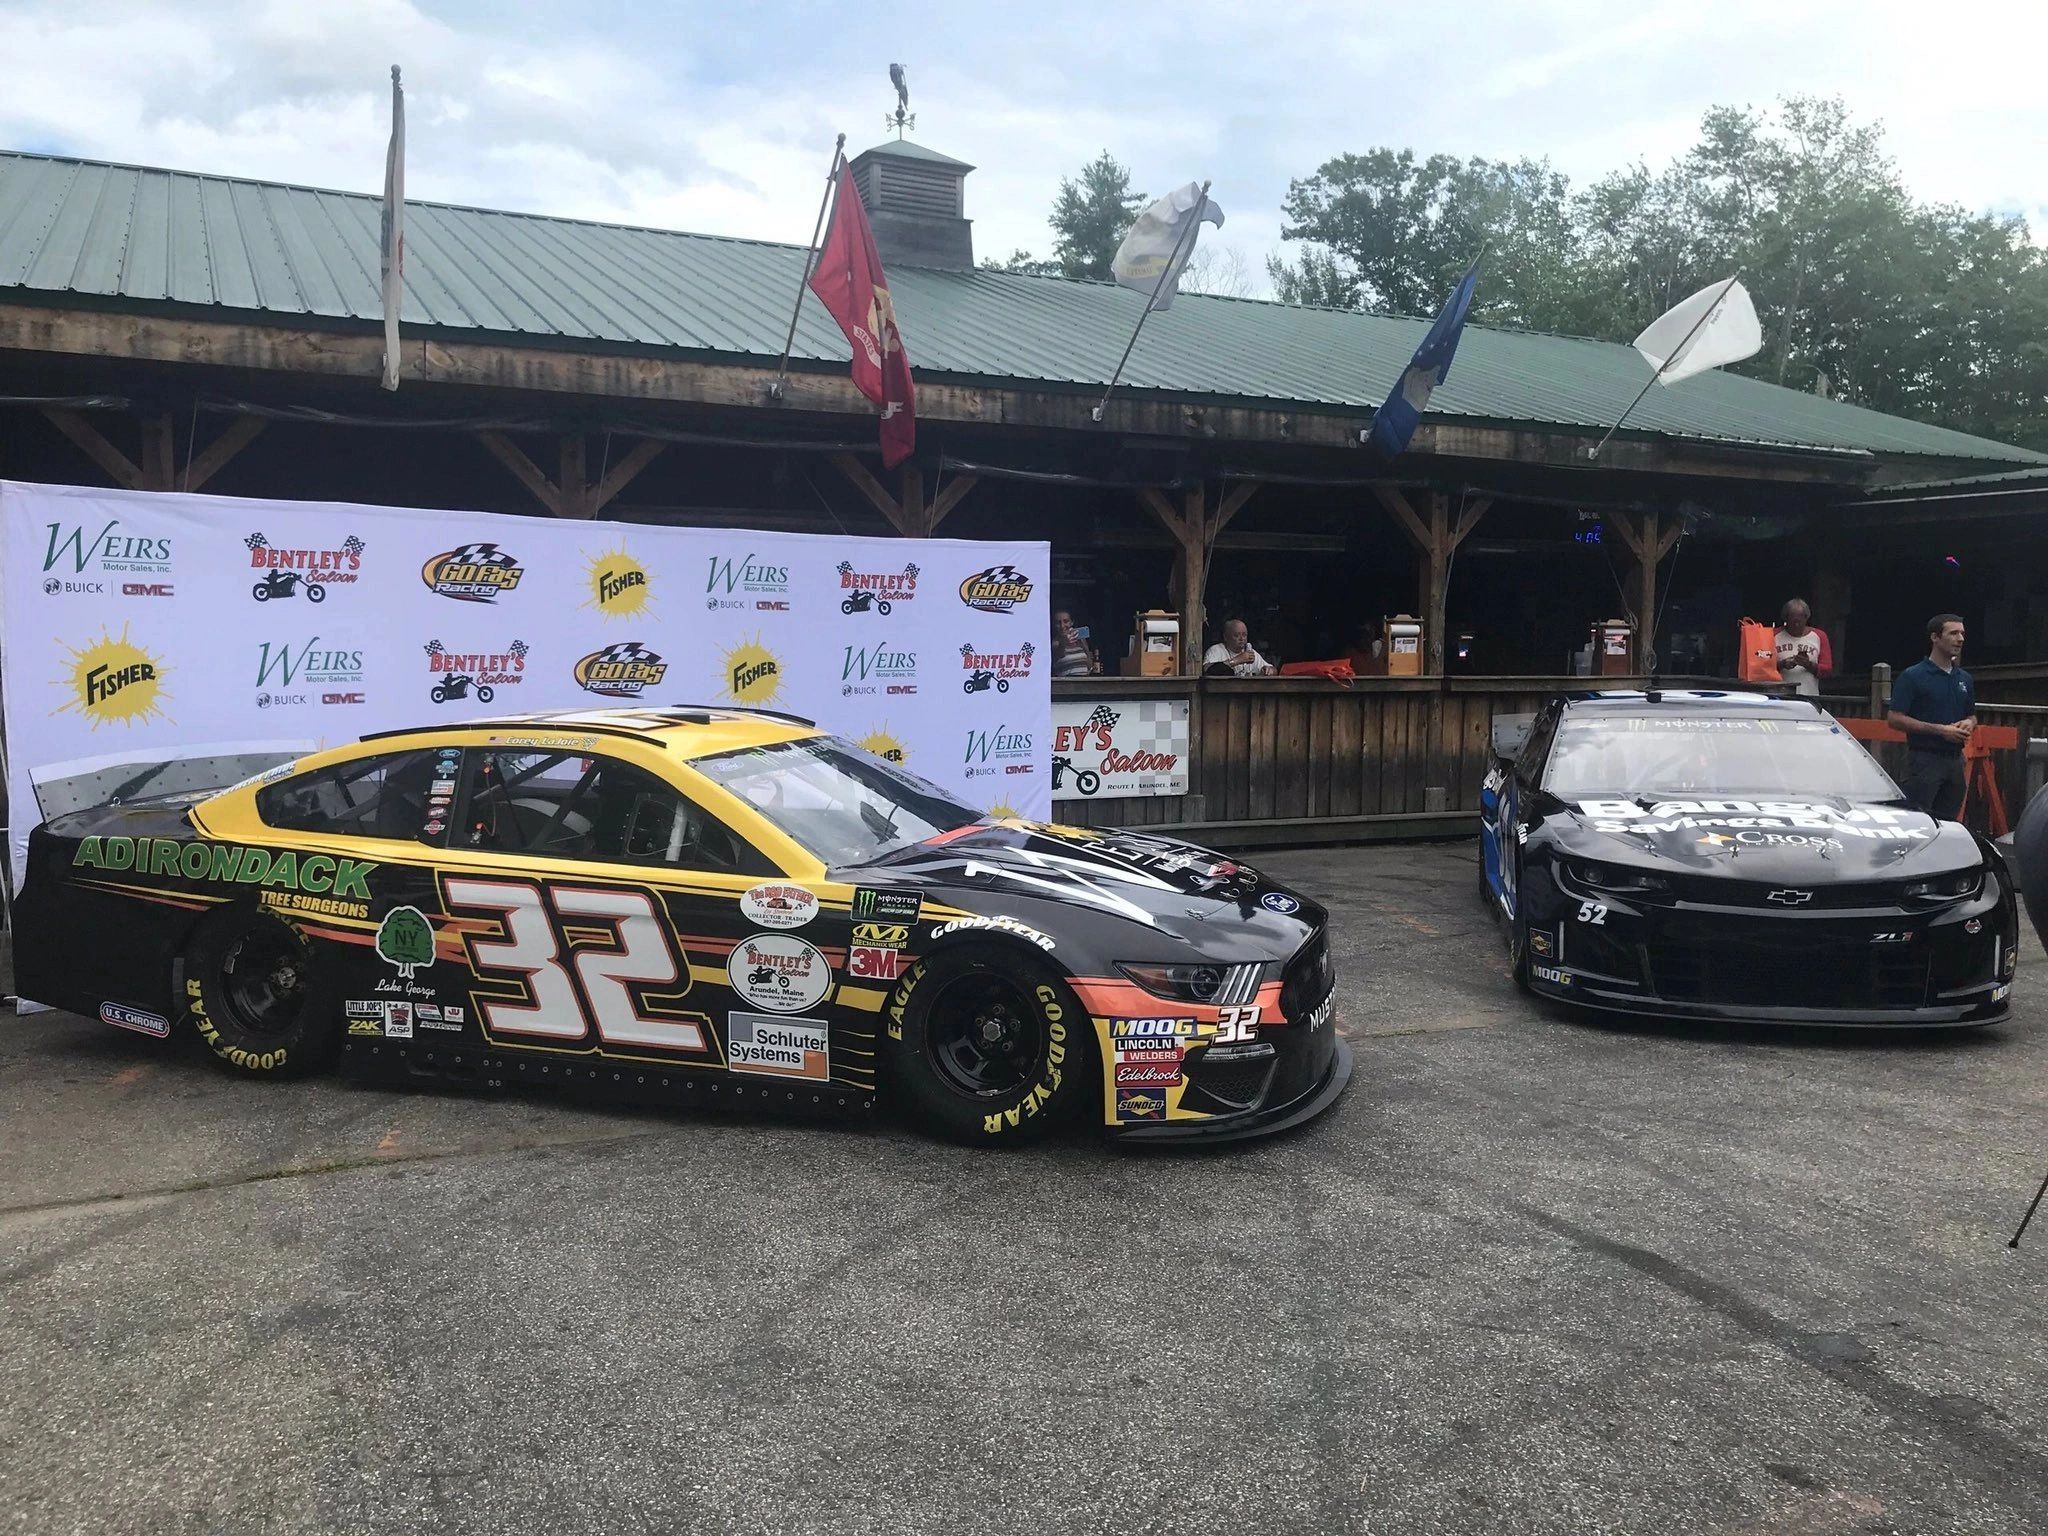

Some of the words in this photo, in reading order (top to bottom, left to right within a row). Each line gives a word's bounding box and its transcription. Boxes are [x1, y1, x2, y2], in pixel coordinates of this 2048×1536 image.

[43, 520, 171, 573] WEIRS
[251, 547, 361, 570] BENTLEY'S
[103, 563, 127, 572] Motor
[130, 564, 155, 573] Sales,
[305, 568, 358, 583] Saloon
[706, 553, 788, 594] WEIRS
[65, 582, 103, 594] BUICK
[122, 584, 174, 597] GMC
[434, 583, 500, 596] Racing
[600, 571, 645, 604] FISHER
[841, 573, 916, 590] BENTLEY'S
[878, 589, 914, 600] Saloon
[968, 598, 1014, 608] Racing
[720, 601, 744, 609] BUICK
[756, 601, 790, 611] GMC
[1775, 643, 1793, 654] RED
[256, 636, 363, 687] WEIRS
[430, 653, 524, 672] BENTLEY'S
[842, 641, 916, 681] WEIRS
[963, 653, 1032, 669] BENTLEY'S
[476, 671, 523, 685] Saloon
[733, 662, 777, 694] FISHER
[997, 668, 1029, 679] Saloon
[87, 663, 155, 707] FISHER
[585, 680, 643, 691] Racing
[854, 686, 876, 695] BUICK
[887, 686, 917, 695] GMC
[274, 695, 307, 705] BUICK
[322, 693, 365, 704] GMC
[1655, 719, 1751, 729] MONSTER
[506, 736, 538, 747] Corey
[541, 737, 579, 746] LaJoie
[965, 724, 1032, 763] WEIRS
[1100, 748, 1177, 775] Saloon
[976, 767, 996, 776] BUICK
[1005, 765, 1033, 774] GMC
[1577, 800, 1908, 823] Bangor
[1594, 817, 1788, 834] Savings
[1789, 816, 1930, 839] Bank
[1735, 831, 1844, 849] CROSS
[72, 836, 379, 900] ADIRONDACK
[260, 890, 291, 907] TREE
[292, 893, 368, 918] SURGEONS
[877, 894, 918, 904] MONSTER
[1577, 902, 1608, 925] 52
[395, 930, 418, 947] NY
[930, 914, 1056, 952] GOODYEAR
[852, 937, 887, 948] MECHANIX
[888, 941, 907, 949] WEAR
[445, 878, 708, 1051] 32
[747, 952, 812, 970] BENTLEY'S
[851, 948, 896, 978] 3M
[778, 968, 810, 978] Saloon
[1533, 965, 1572, 984] MOOG
[375, 979, 402, 992] Lake
[406, 981, 436, 999] George
[782, 988, 805, 997] Maine
[347, 1001, 365, 1011] LITTLE
[366, 1001, 382, 1011] JOE'S
[888, 961, 927, 1041] EAGLE
[105, 1007, 123, 1020] U.S.
[125, 1013, 164, 1031] CHROME
[187, 978, 288, 1070] GOODYEAR
[348, 1020, 382, 1030] ZAK
[1113, 1019, 1194, 1036] MOOG
[1211, 1004, 1262, 1044] 32
[388, 1025, 411, 1033] ASP
[757, 1029, 826, 1051] Schluter
[1118, 1039, 1171, 1050] LINCOLN
[730, 1042, 801, 1063] Systems
[983, 984, 1067, 1134] GOODYEAR
[1129, 1051, 1178, 1060] WELDERS
[1117, 1067, 1180, 1081] Edelbrock
[1119, 1101, 1162, 1110] SUNOCO
